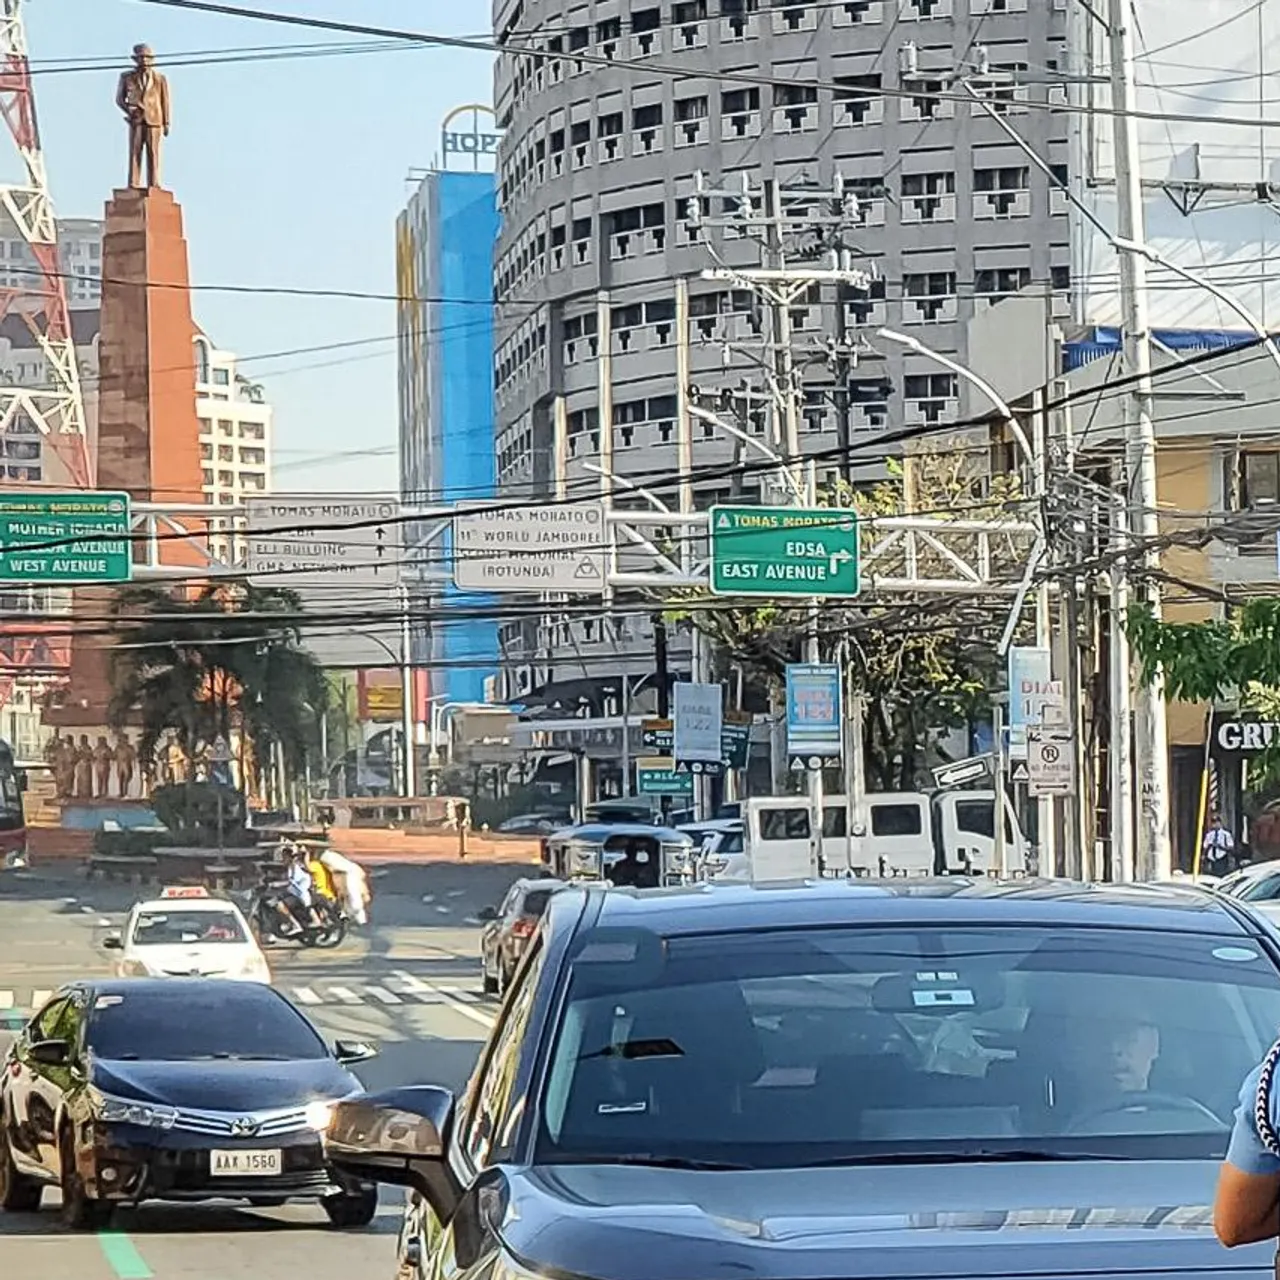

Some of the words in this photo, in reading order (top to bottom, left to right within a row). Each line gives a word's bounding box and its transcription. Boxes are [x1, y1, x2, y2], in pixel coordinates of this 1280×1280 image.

[270, 505, 315, 517] TOMAS
[322, 505, 376, 517] MORATO
[480, 511, 523, 521] TOMAS
[529, 511, 584, 522] MORATO
[733, 514, 777, 527] TOMAS
[484, 531, 530, 542] WORLD
[535, 531, 600, 543] JAMBOREE
[71, 541, 125, 553] AVENUE
[284, 544, 346, 555] BUILDING
[786, 542, 826, 557] EDSA
[10, 559, 48, 572] WEST
[52, 559, 107, 572] AVENUE
[482, 565, 555, 577] (ROTUNDA)
[722, 564, 759, 578] EAST
[765, 565, 826, 580] AVENUE
